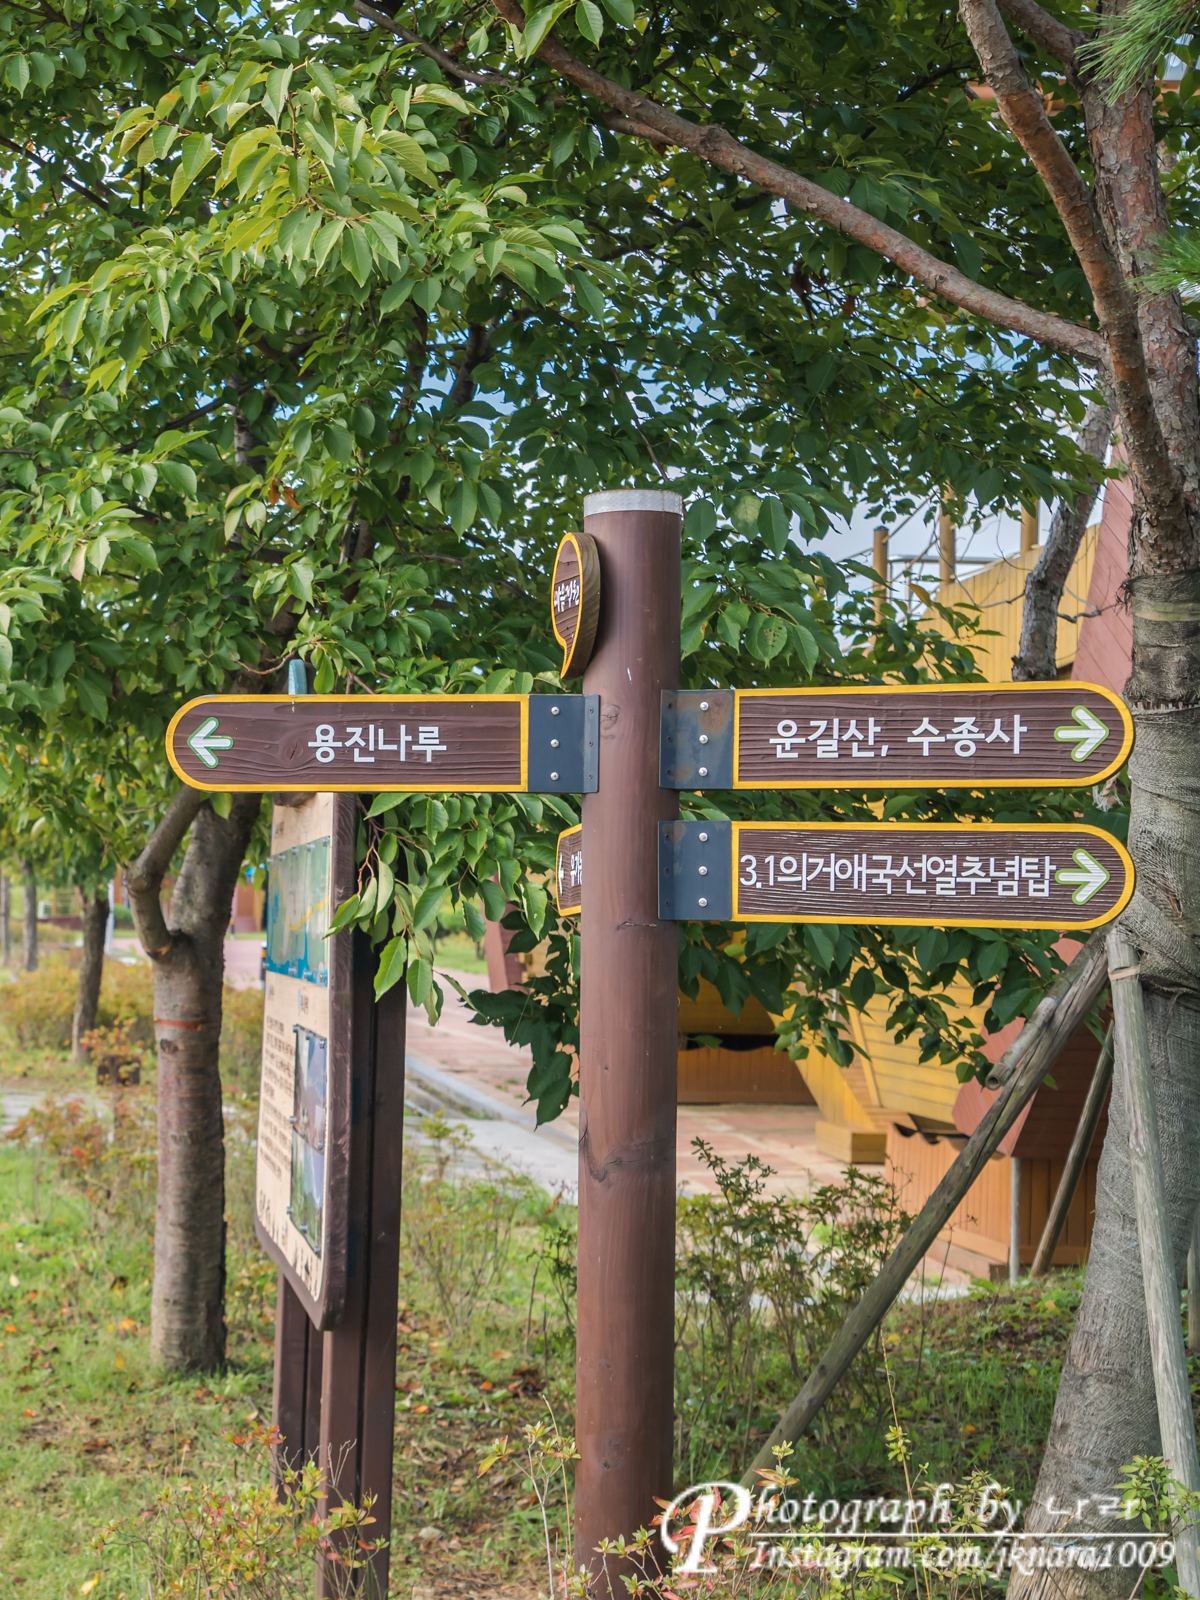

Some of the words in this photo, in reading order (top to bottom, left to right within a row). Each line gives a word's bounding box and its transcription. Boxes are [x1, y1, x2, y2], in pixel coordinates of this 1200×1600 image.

[308, 724, 447, 763] 용진나루
[769, 717, 889, 758] 운길산,
[906, 714, 1028, 758] 수종사
[739, 852, 1057, 898] 3.1의거애국선열추념탑
